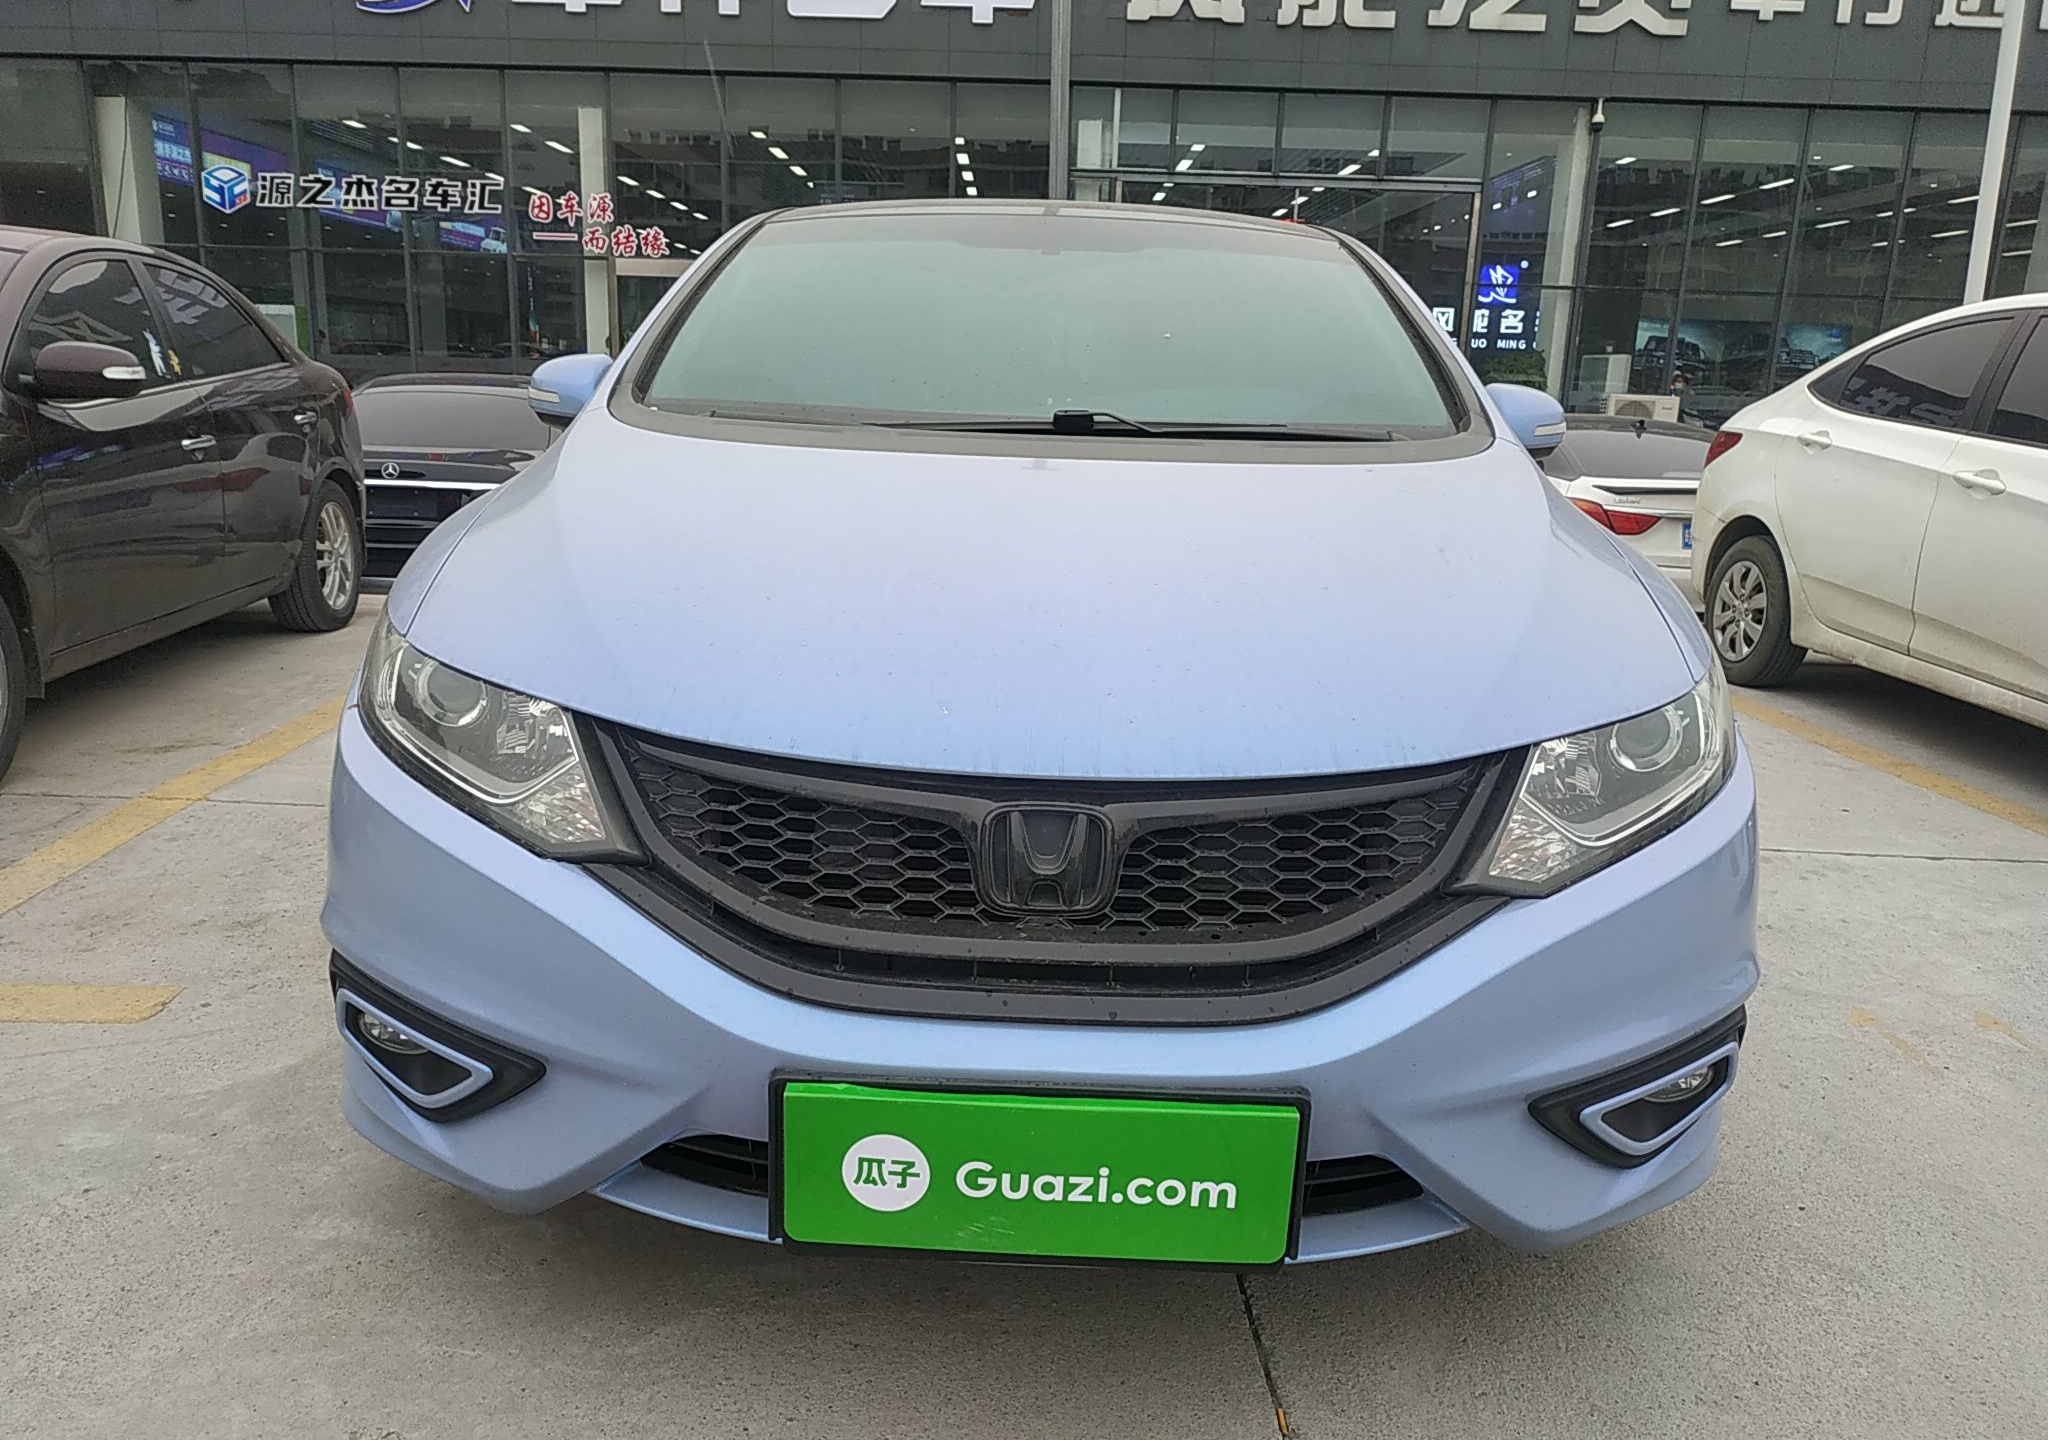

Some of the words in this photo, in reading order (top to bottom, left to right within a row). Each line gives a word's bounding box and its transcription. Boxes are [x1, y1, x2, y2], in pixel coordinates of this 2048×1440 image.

[256, 172, 504, 214] 源之杰名车汇
[529, 190, 614, 227] 因车源
[1496, 339, 1527, 350] MING
[851, 1155, 922, 1190] 瓜子
[954, 1160, 1238, 1210] Guazi.com
